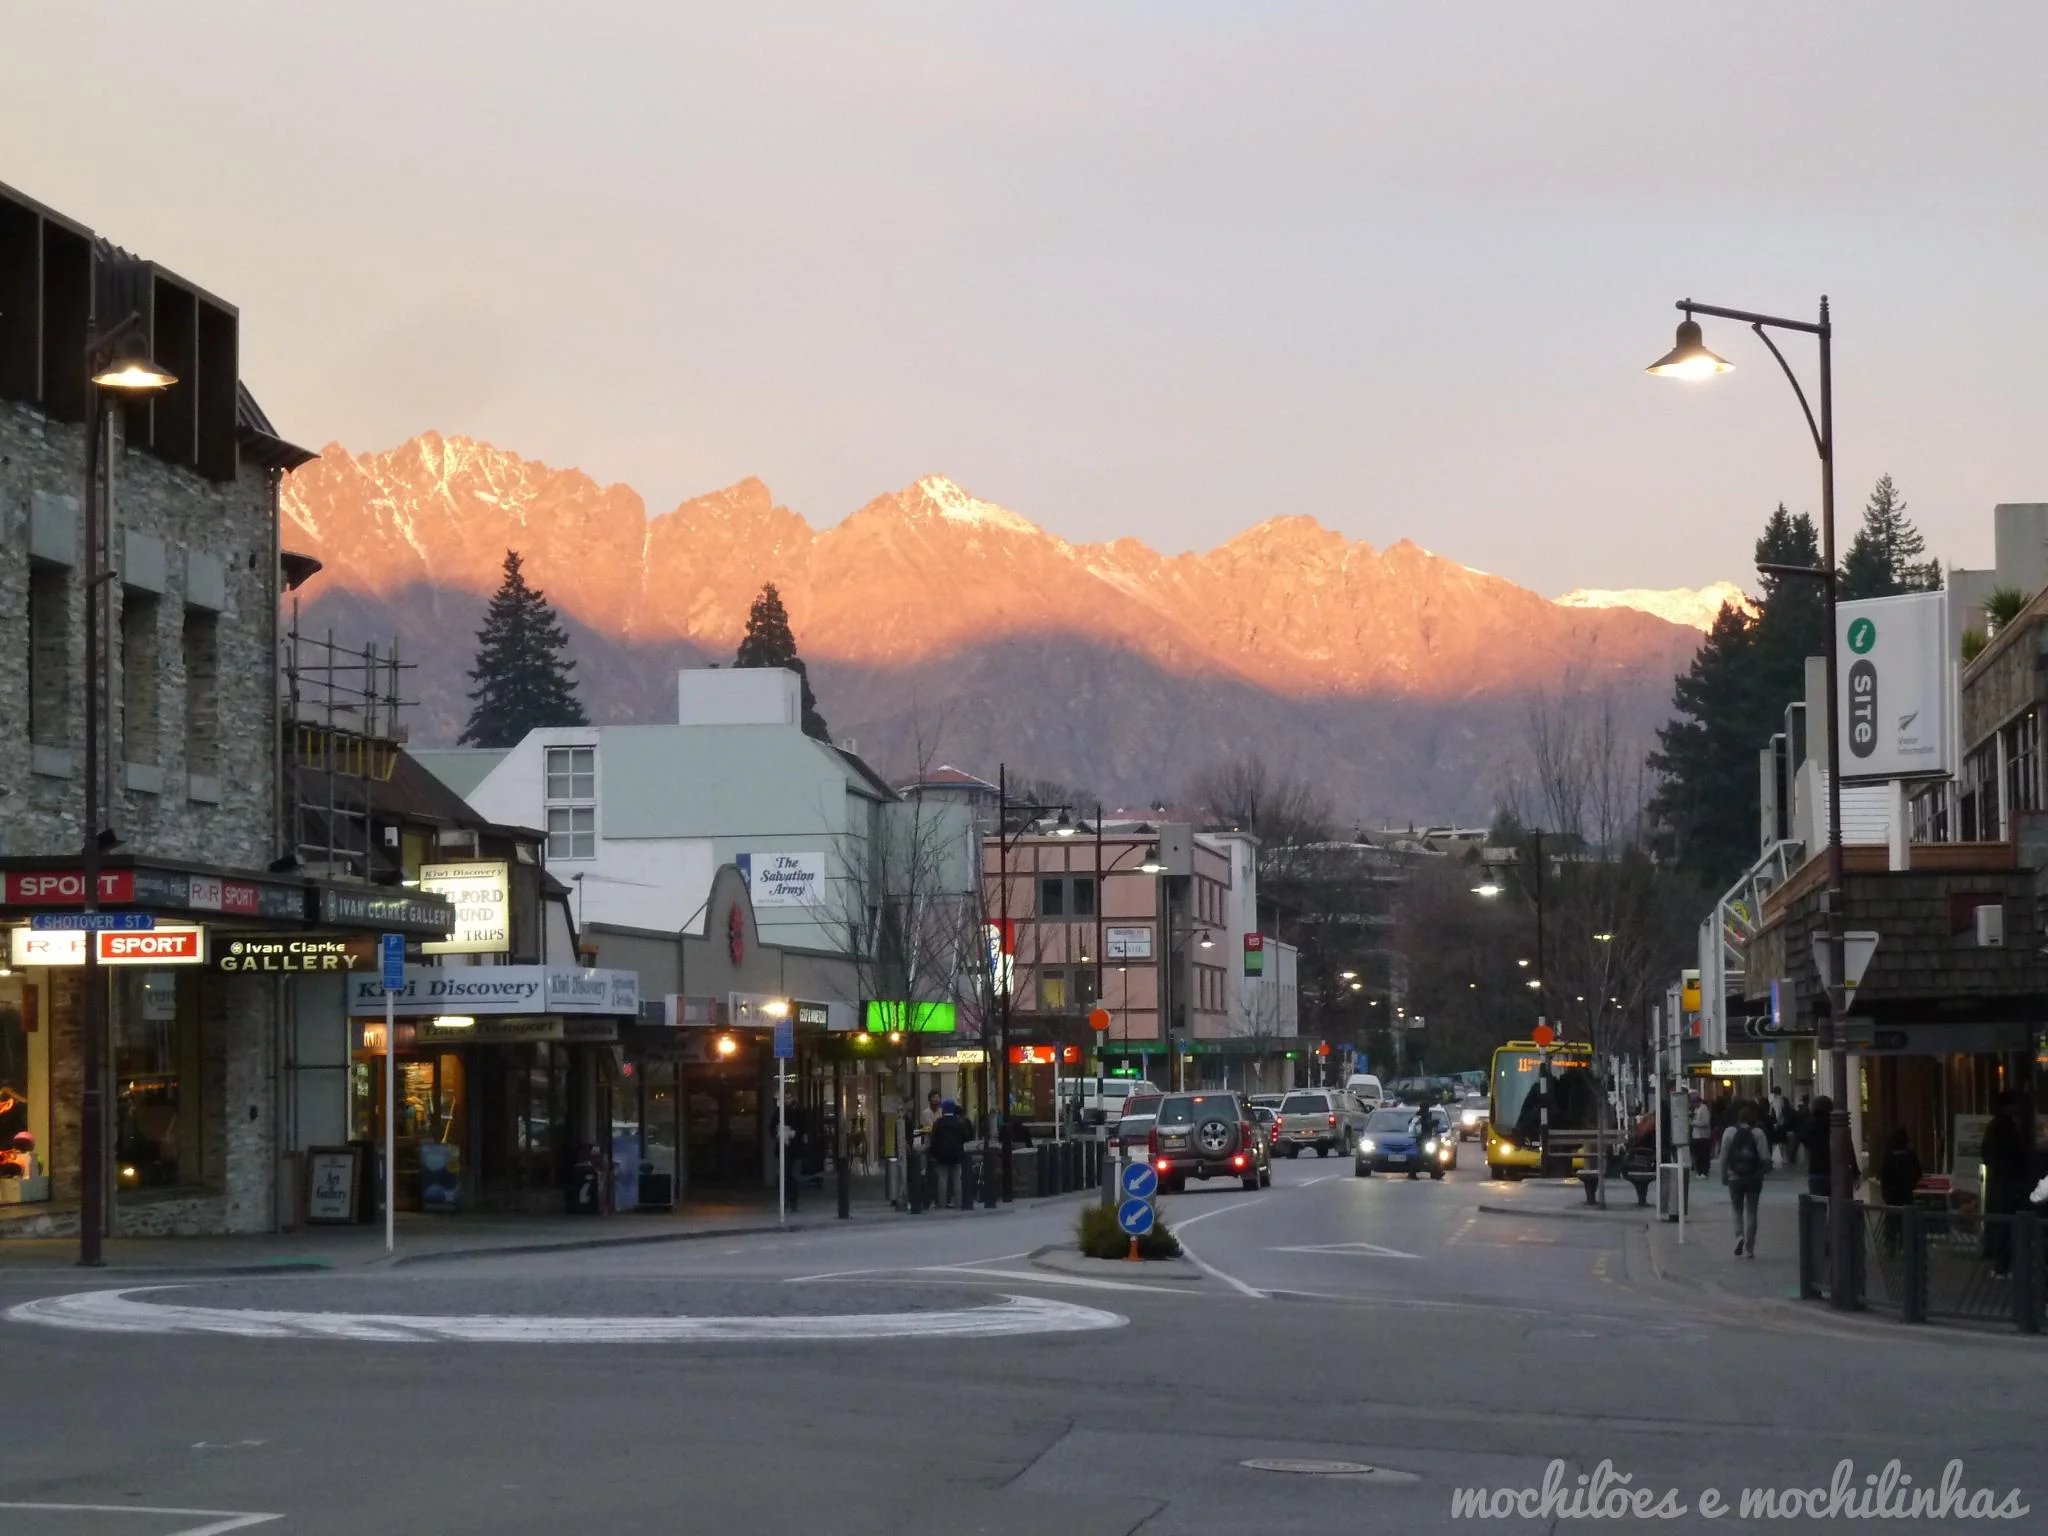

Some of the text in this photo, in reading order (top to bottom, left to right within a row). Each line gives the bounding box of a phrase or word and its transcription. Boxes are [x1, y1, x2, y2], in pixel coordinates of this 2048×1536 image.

[775, 856, 799, 869] The
[424, 867, 505, 879] Kiwi Discovery
[760, 869, 815, 883] Salvation
[19, 875, 120, 897] SPOT
[769, 883, 806, 897] Army
[225, 887, 254, 906] SPORT
[339, 897, 452, 926] IVAN CLARKE GALLERY
[43, 914, 141, 930] SHOTOVER ST
[464, 928, 504, 942] TRIPS
[111, 936, 187, 954] SPORT
[245, 941, 346, 954] Ivan Clarke
[219, 953, 359, 972] GALLERY
[427, 978, 540, 998] Discovery
[572, 975, 606, 999] Discovery
